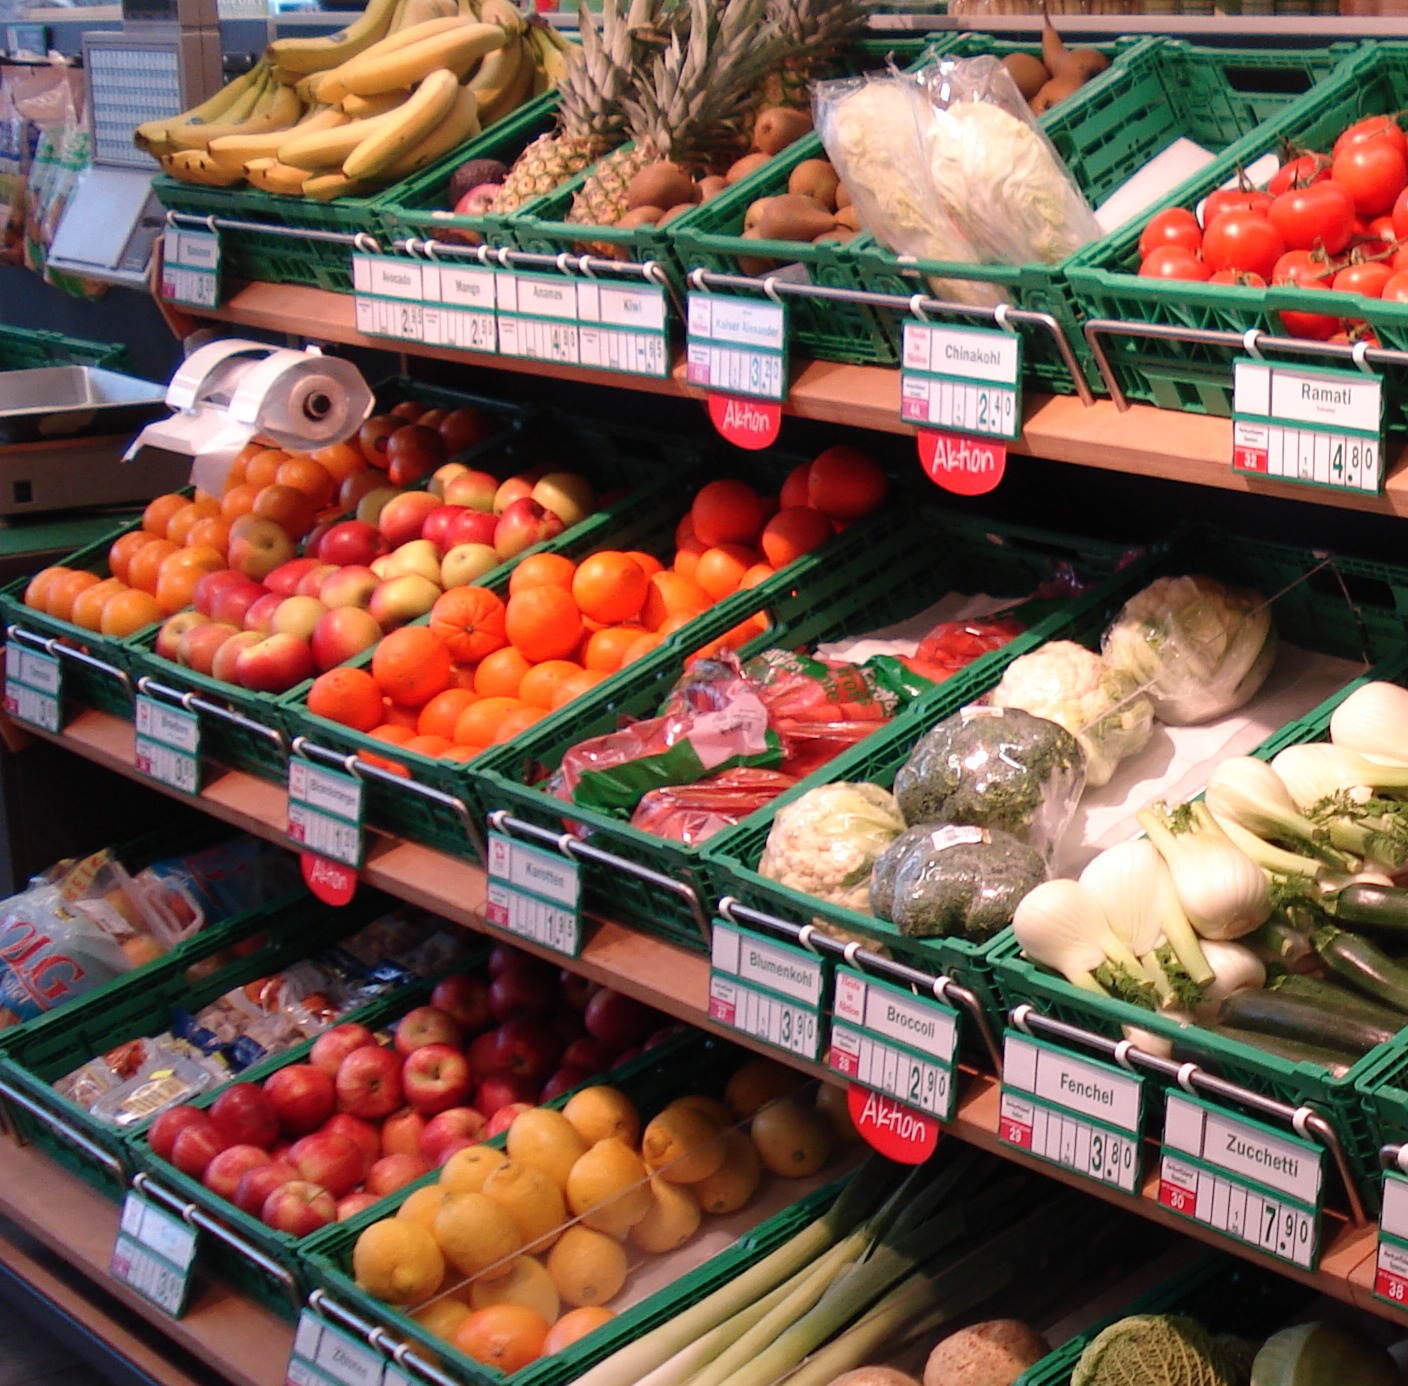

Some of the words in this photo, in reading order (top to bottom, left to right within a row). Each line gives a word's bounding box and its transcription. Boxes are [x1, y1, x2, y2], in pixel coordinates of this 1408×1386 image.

[455, 280, 480, 296] Mango
[533, 286, 563, 300] Ananas
[623, 300, 642, 312] Kiwi
[945, 344, 1001, 366] Chinakohl
[1301, 383, 1351, 405] Ramati
[723, 399, 771, 433] Aktion
[932, 438, 994, 474] Aktion
[1244, 453, 1257, 468] 32
[1333, 444, 1373, 482] 4.80
[750, 952, 812, 987] Blumenkohl
[887, 1006, 935, 1039] Broccoli
[911, 1066, 945, 1104] 2.90
[1060, 1073, 1113, 1106] Fenchel
[860, 1092, 925, 1143] Aktion
[1092, 1135, 1132, 1177] 3.80
[1226, 1133, 1298, 1178] Zucchetti
[1171, 1191, 1184, 1209] 30
[1265, 1205, 1308, 1250] 7.90
[1389, 1281, 1404, 1300] 38
